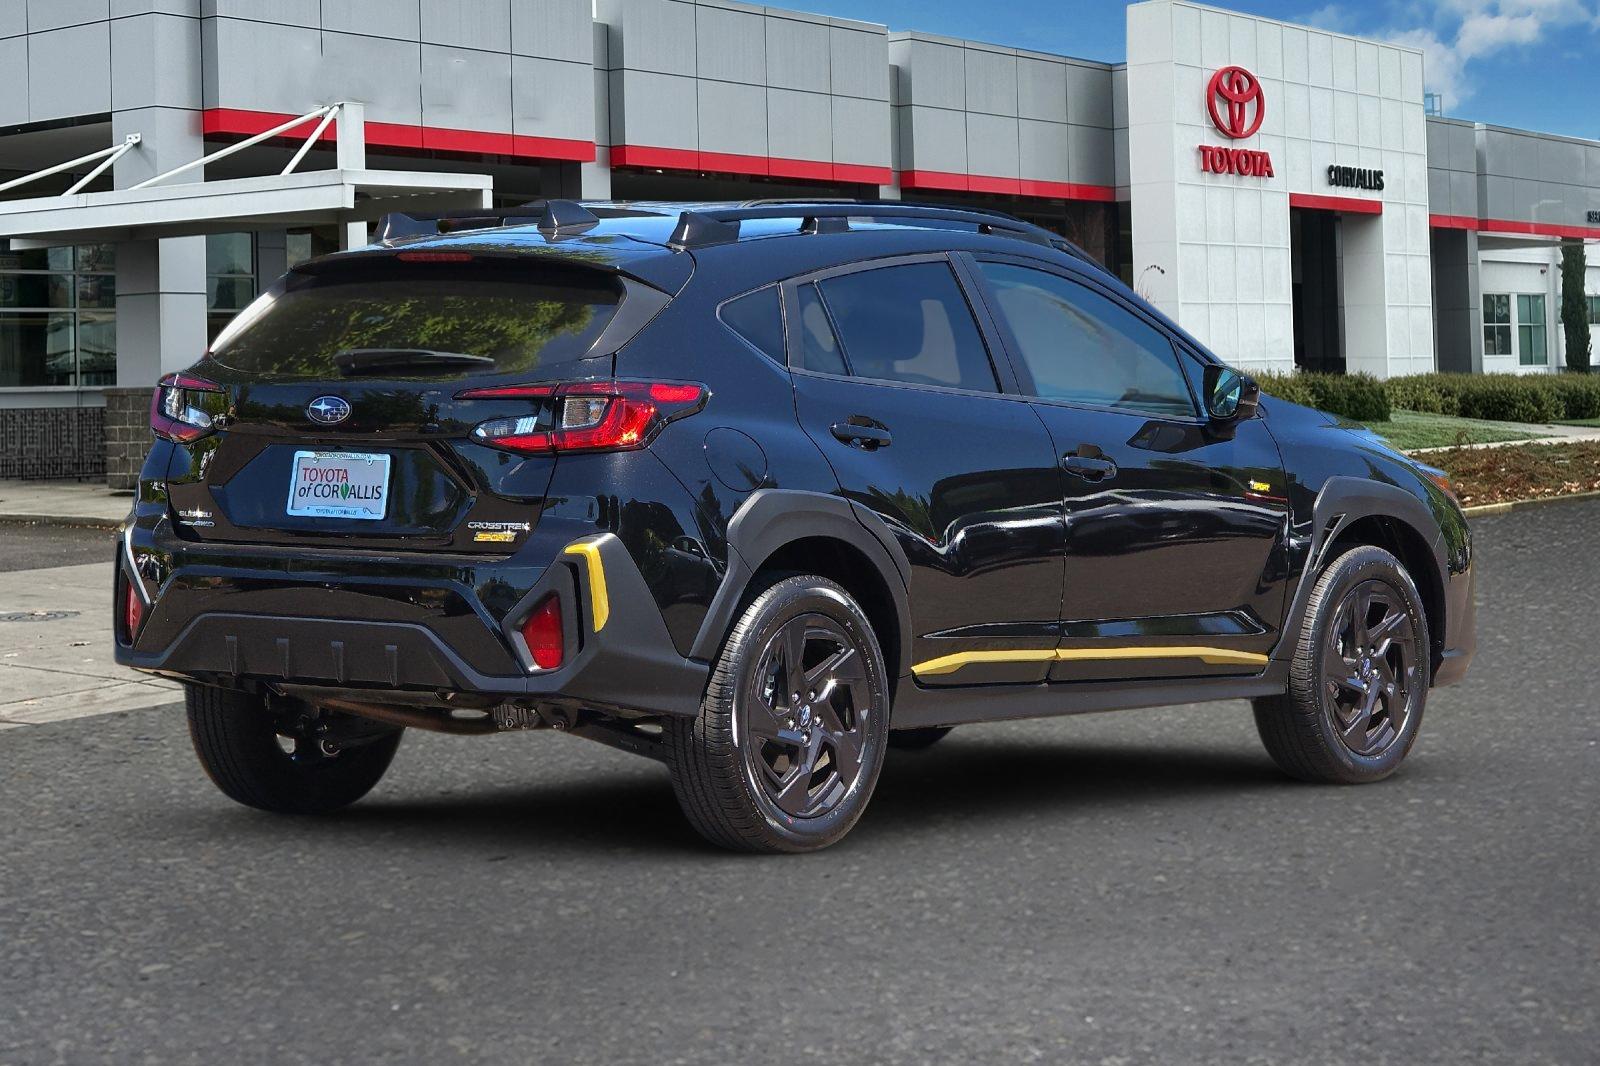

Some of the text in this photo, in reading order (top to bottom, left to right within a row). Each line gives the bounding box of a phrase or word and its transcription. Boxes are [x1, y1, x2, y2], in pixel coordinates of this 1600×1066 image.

[1198, 145, 1275, 178] TOYOTA
[1328, 165, 1385, 190] CORVALLIS
[303, 468, 349, 483] TOYOTA
[298, 483, 313, 497] of
[467, 521, 531, 530] CROSSTREK
[475, 532, 515, 541] SPORT
